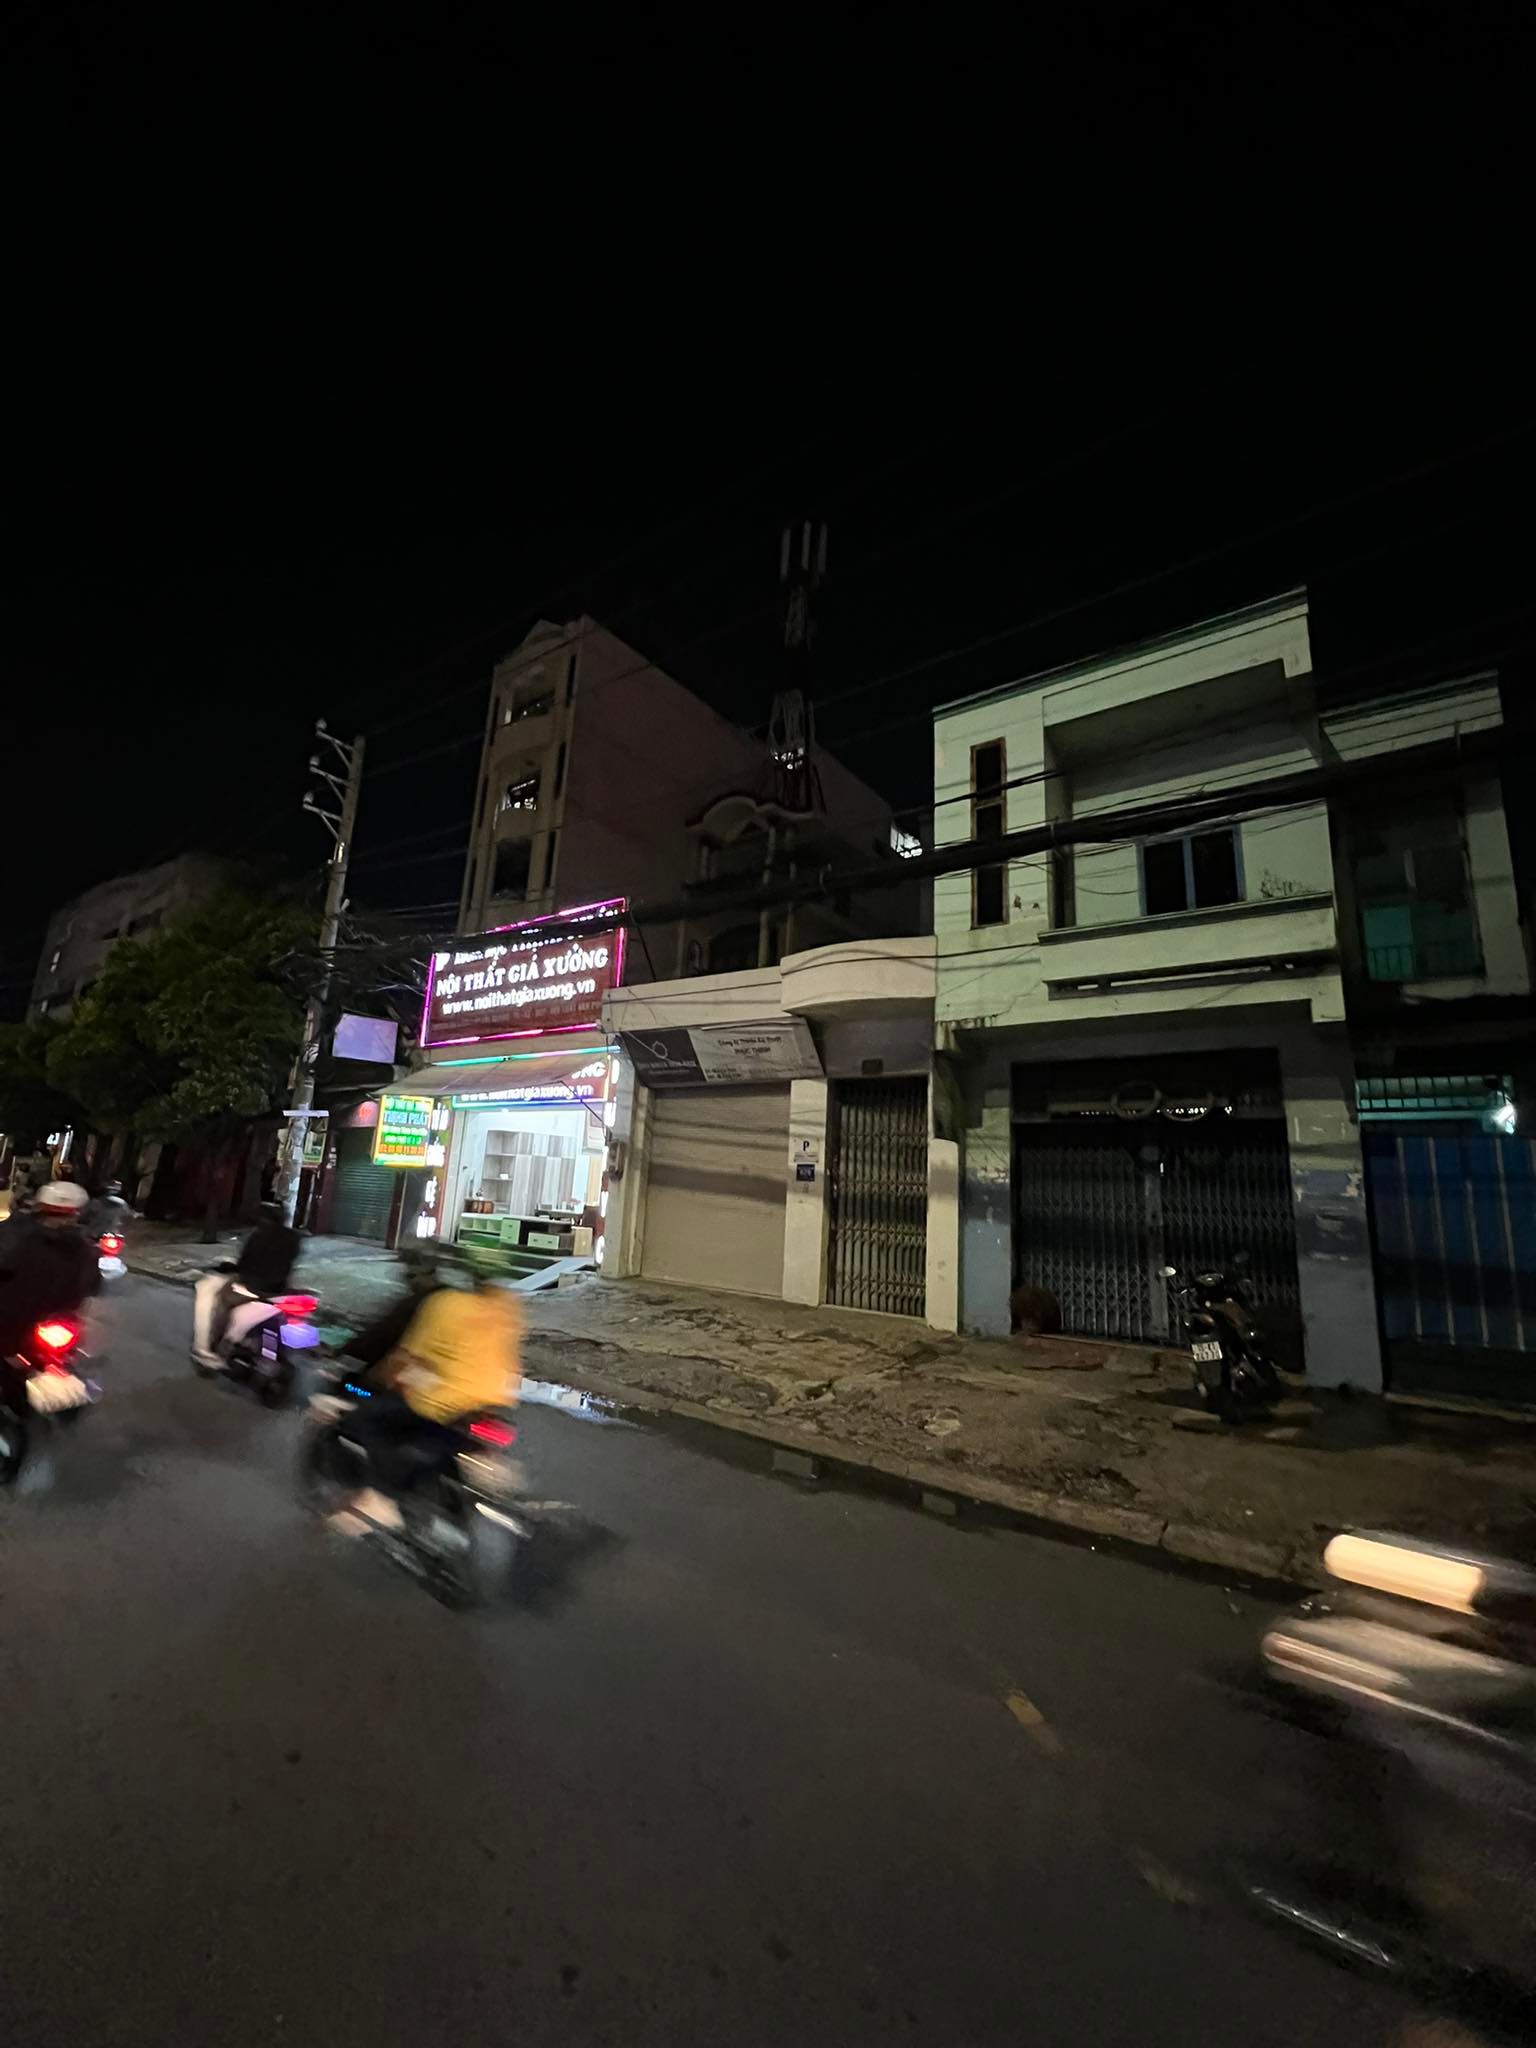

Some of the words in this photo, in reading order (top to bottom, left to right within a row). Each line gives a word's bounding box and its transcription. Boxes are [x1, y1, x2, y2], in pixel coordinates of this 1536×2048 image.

[436, 973, 460, 999] NỘI
[464, 960, 506, 991] THẤT
[508, 955, 540, 983] GIÁ
[543, 943, 609, 977] XƯỞNG
[442, 977, 595, 1015] www.noithatgiaxuong.vn
